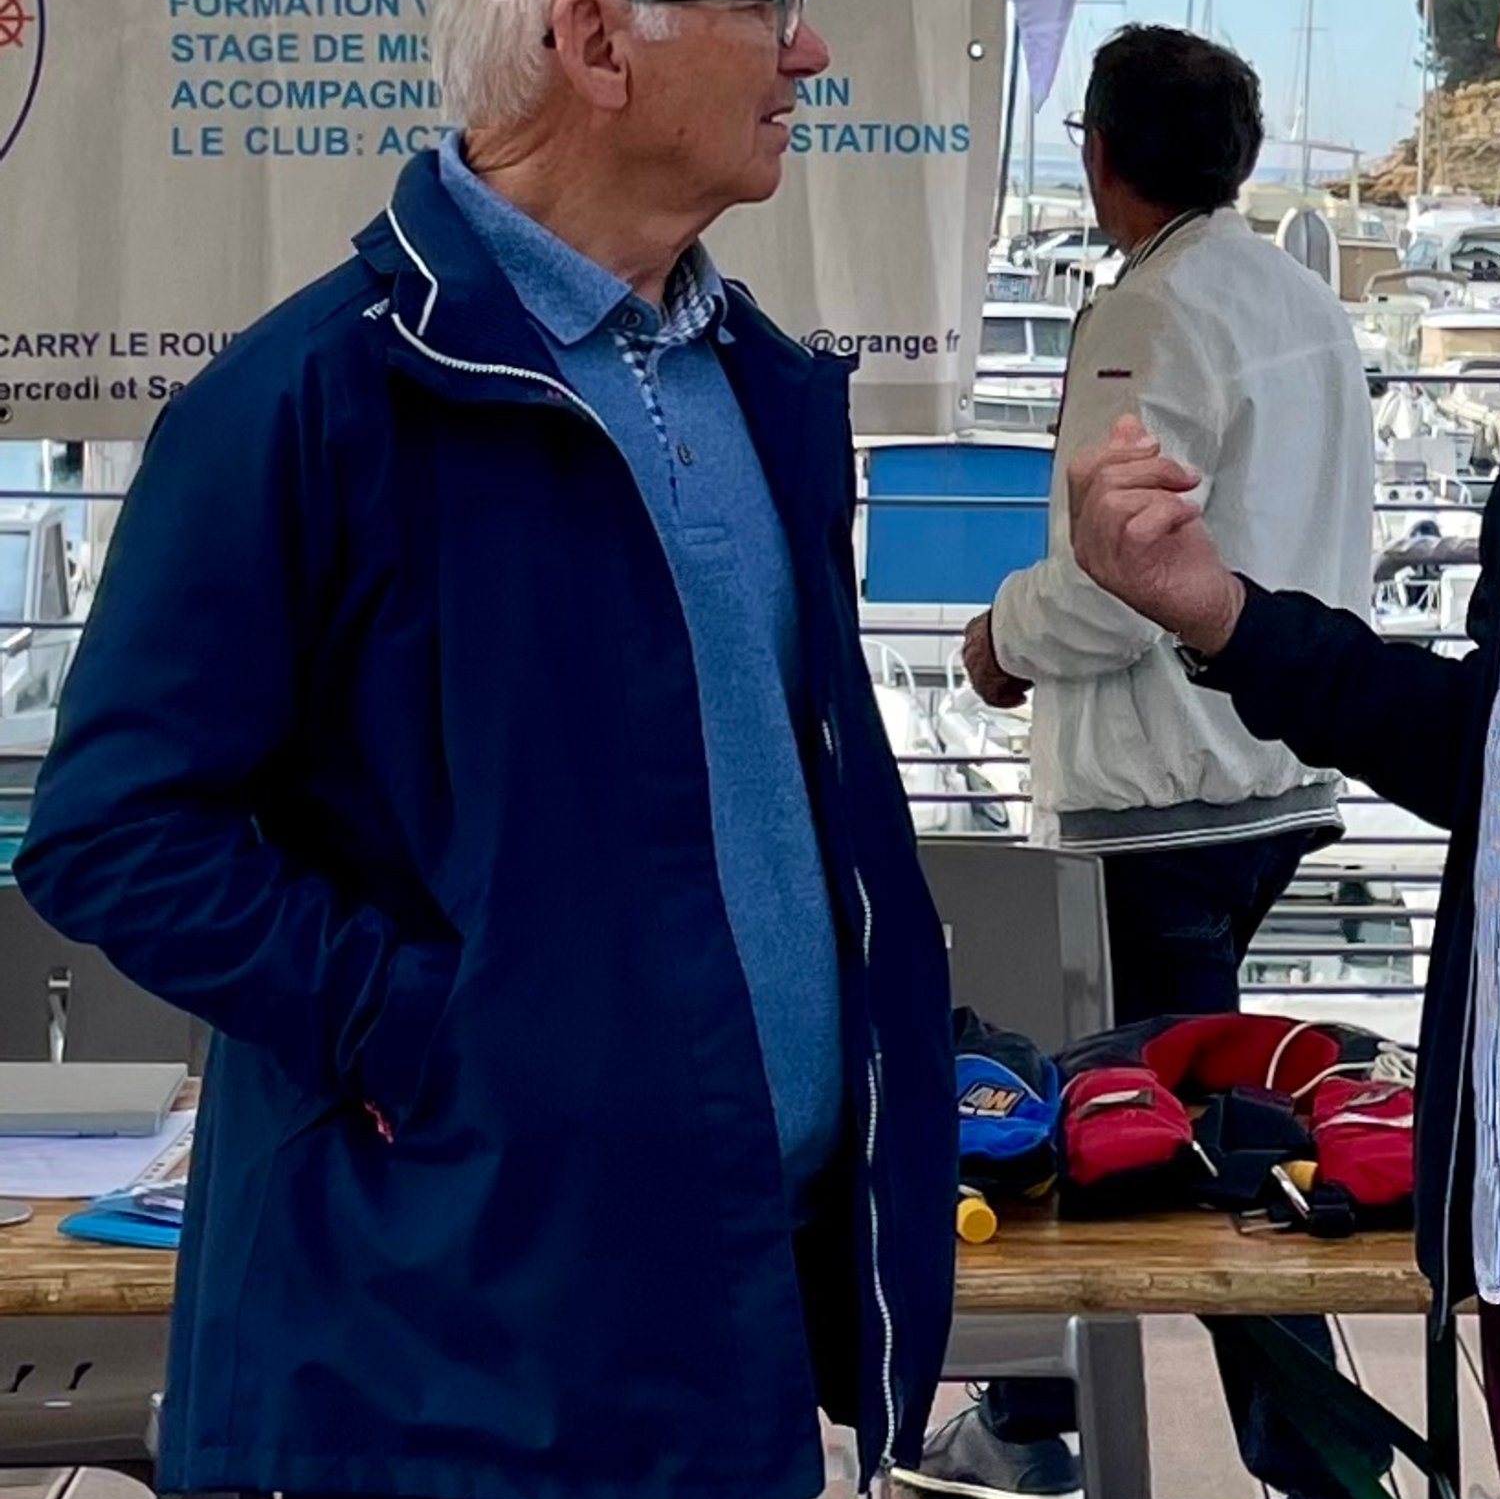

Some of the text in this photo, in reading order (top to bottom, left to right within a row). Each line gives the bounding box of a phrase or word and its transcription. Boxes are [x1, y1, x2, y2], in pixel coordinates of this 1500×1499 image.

[171, 34, 299, 62] STAGE
[313, 34, 364, 62] DE
[172, 126, 222, 155] LE
[789, 122, 971, 154] STATIONS
[110, 332, 149, 357] LE
[159, 332, 240, 358] ROU
[110, 377, 138, 400] et
